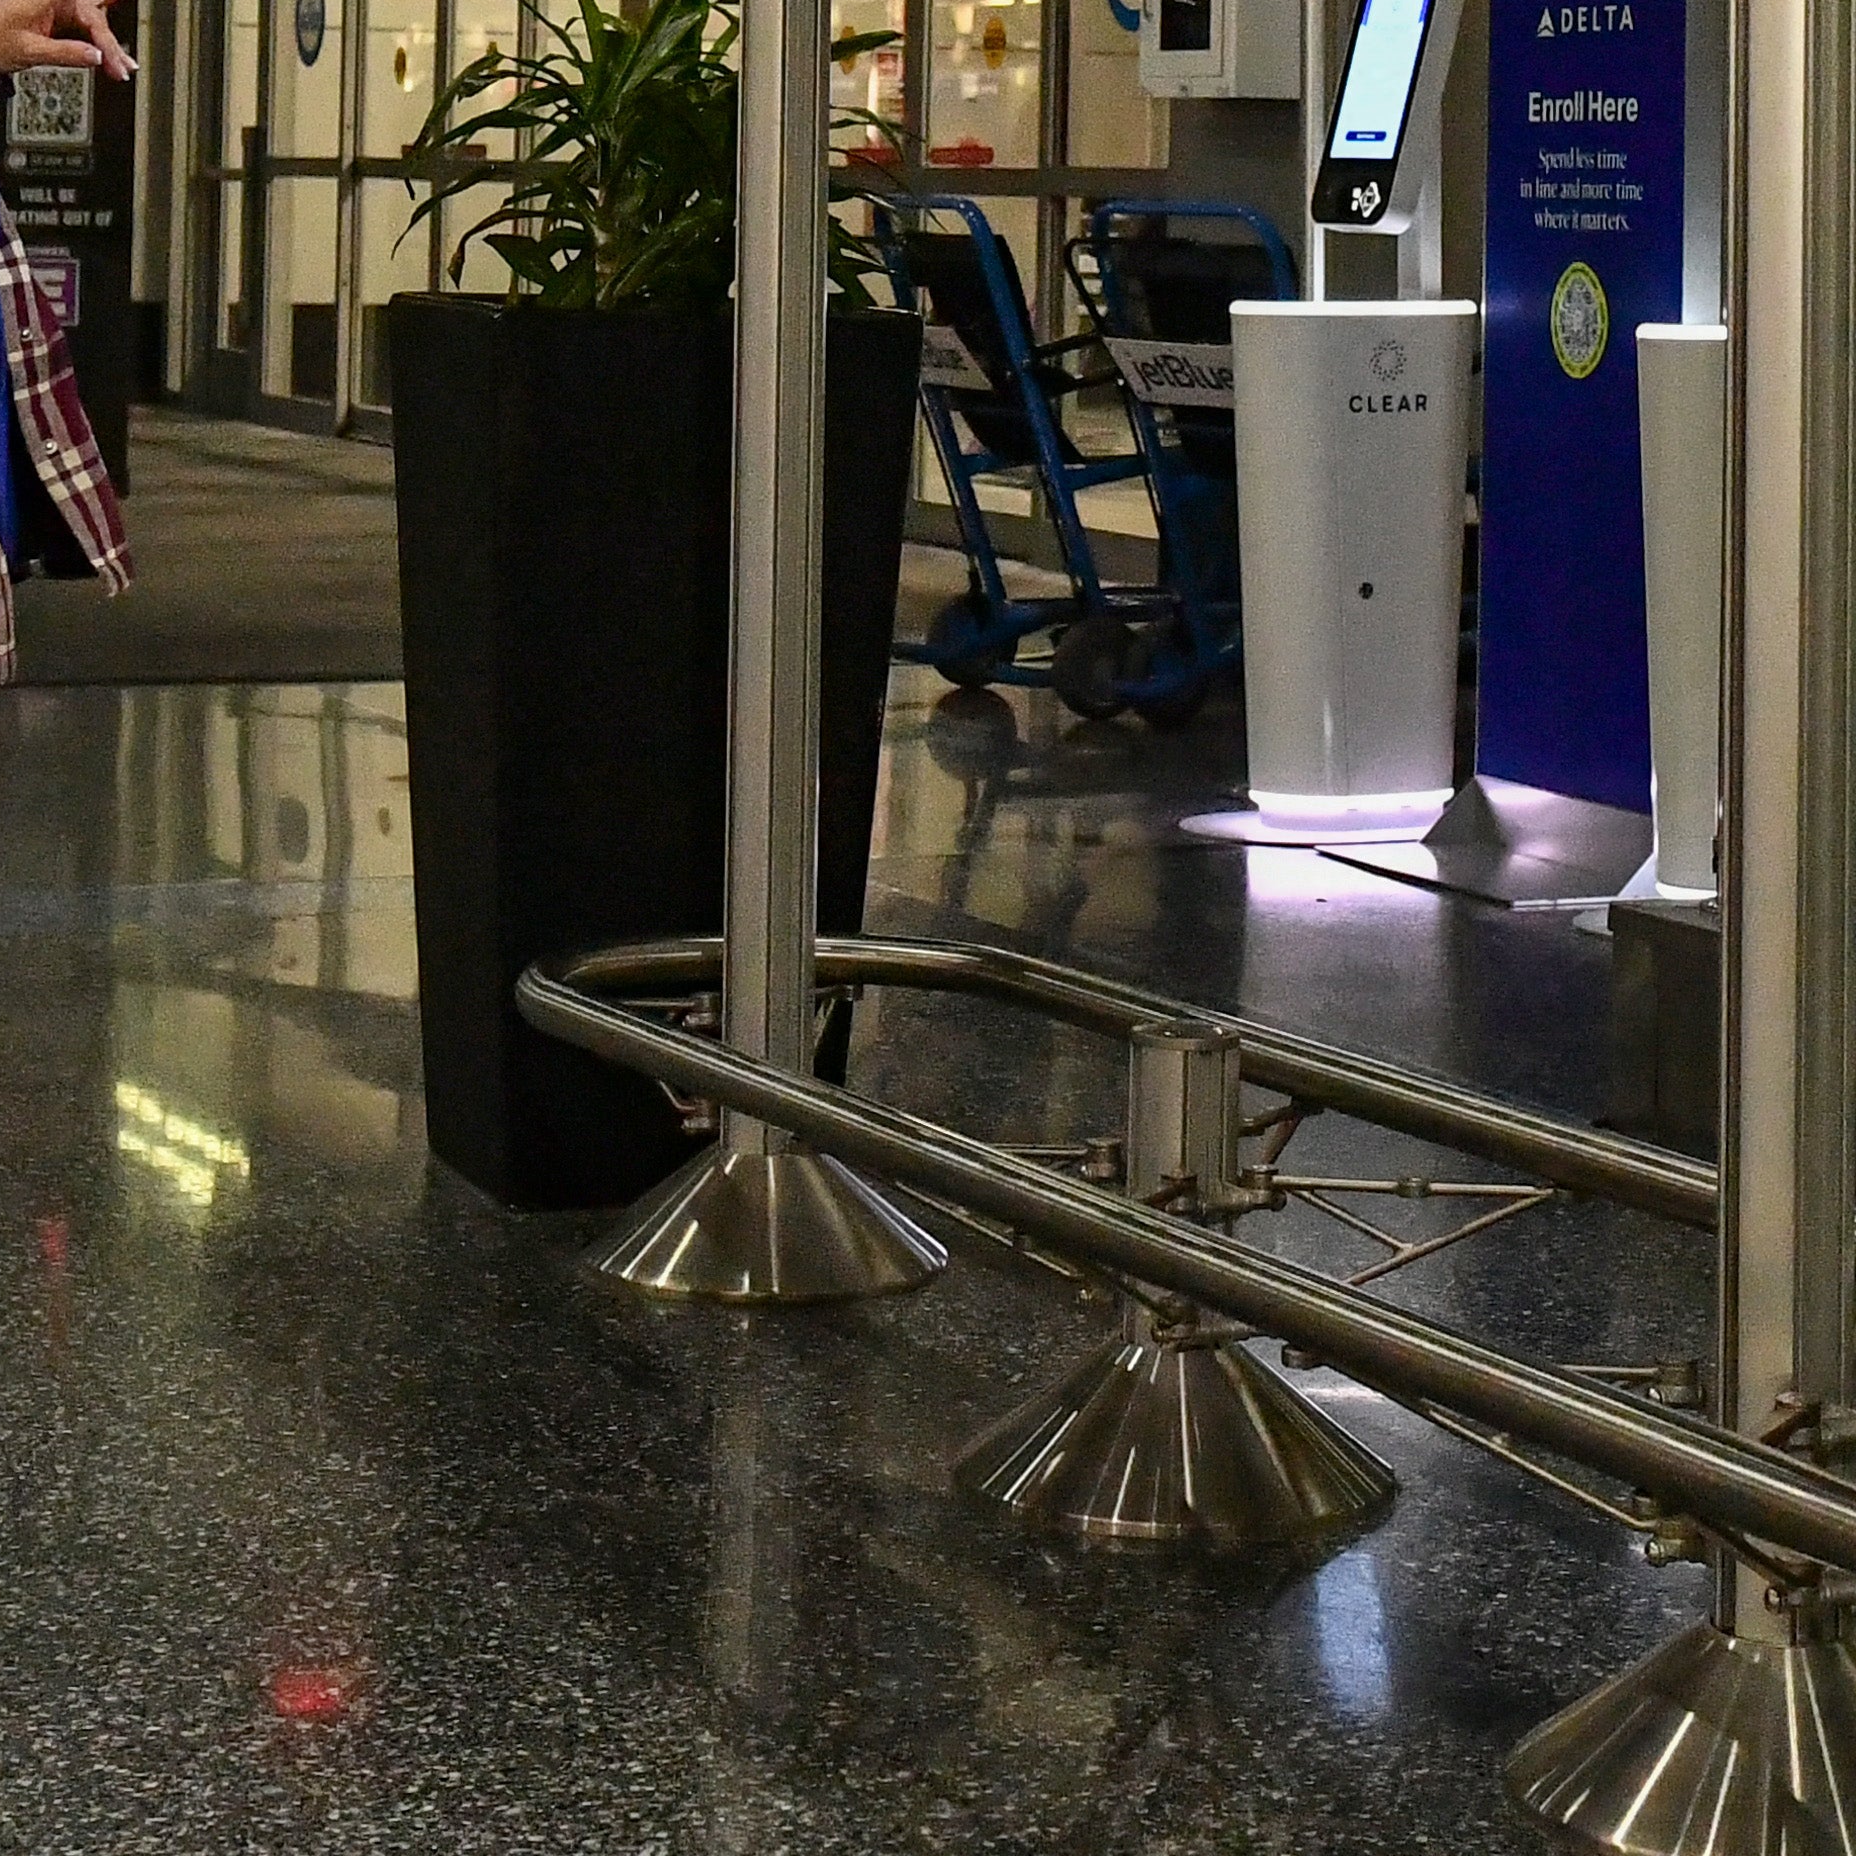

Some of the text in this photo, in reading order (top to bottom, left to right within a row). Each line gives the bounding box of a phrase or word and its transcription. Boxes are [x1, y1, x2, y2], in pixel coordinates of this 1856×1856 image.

[1560, 4, 1634, 34] DELTA
[1528, 90, 1639, 122] Enroll Here
[1539, 146, 1628, 175] Spend less time
[1520, 176, 1644, 201] in line and more time
[1534, 207, 1571, 229] where
[1572, 209, 1579, 230] it
[1132, 353, 1234, 394] jetBlue
[1348, 394, 1429, 414] CLEAR
